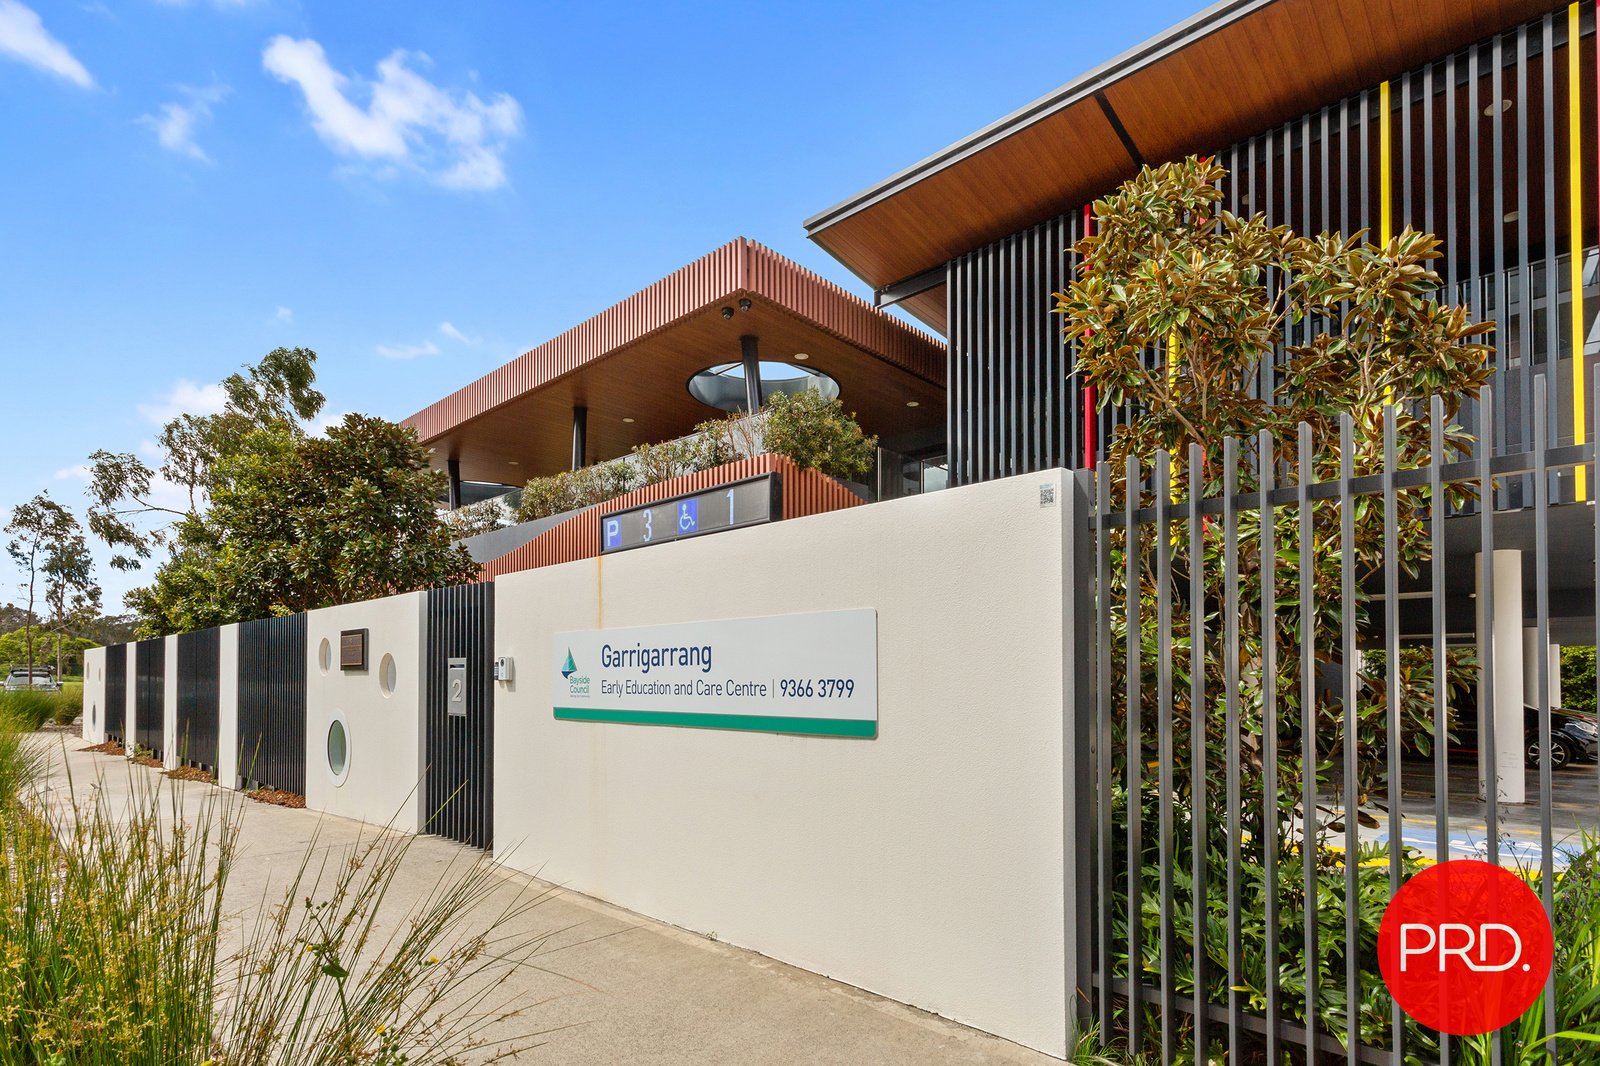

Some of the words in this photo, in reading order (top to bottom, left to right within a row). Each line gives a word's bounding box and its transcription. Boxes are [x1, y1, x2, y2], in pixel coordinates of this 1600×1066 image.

[606, 520, 619, 546] P
[643, 509, 652, 542] 3
[726, 489, 734, 525] 1
[601, 643, 712, 673] Garrigarrang
[452, 679, 463, 702] 2
[570, 676, 590, 685] Bayside
[570, 685, 590, 694] Council
[601, 679, 623, 698] Early
[625, 679, 671, 696] Education
[674, 680, 693, 696] and
[696, 679, 723, 696] Care
[727, 679, 767, 697] Centre
[780, 679, 814, 698] 9366
[817, 679, 855, 699] 3799
